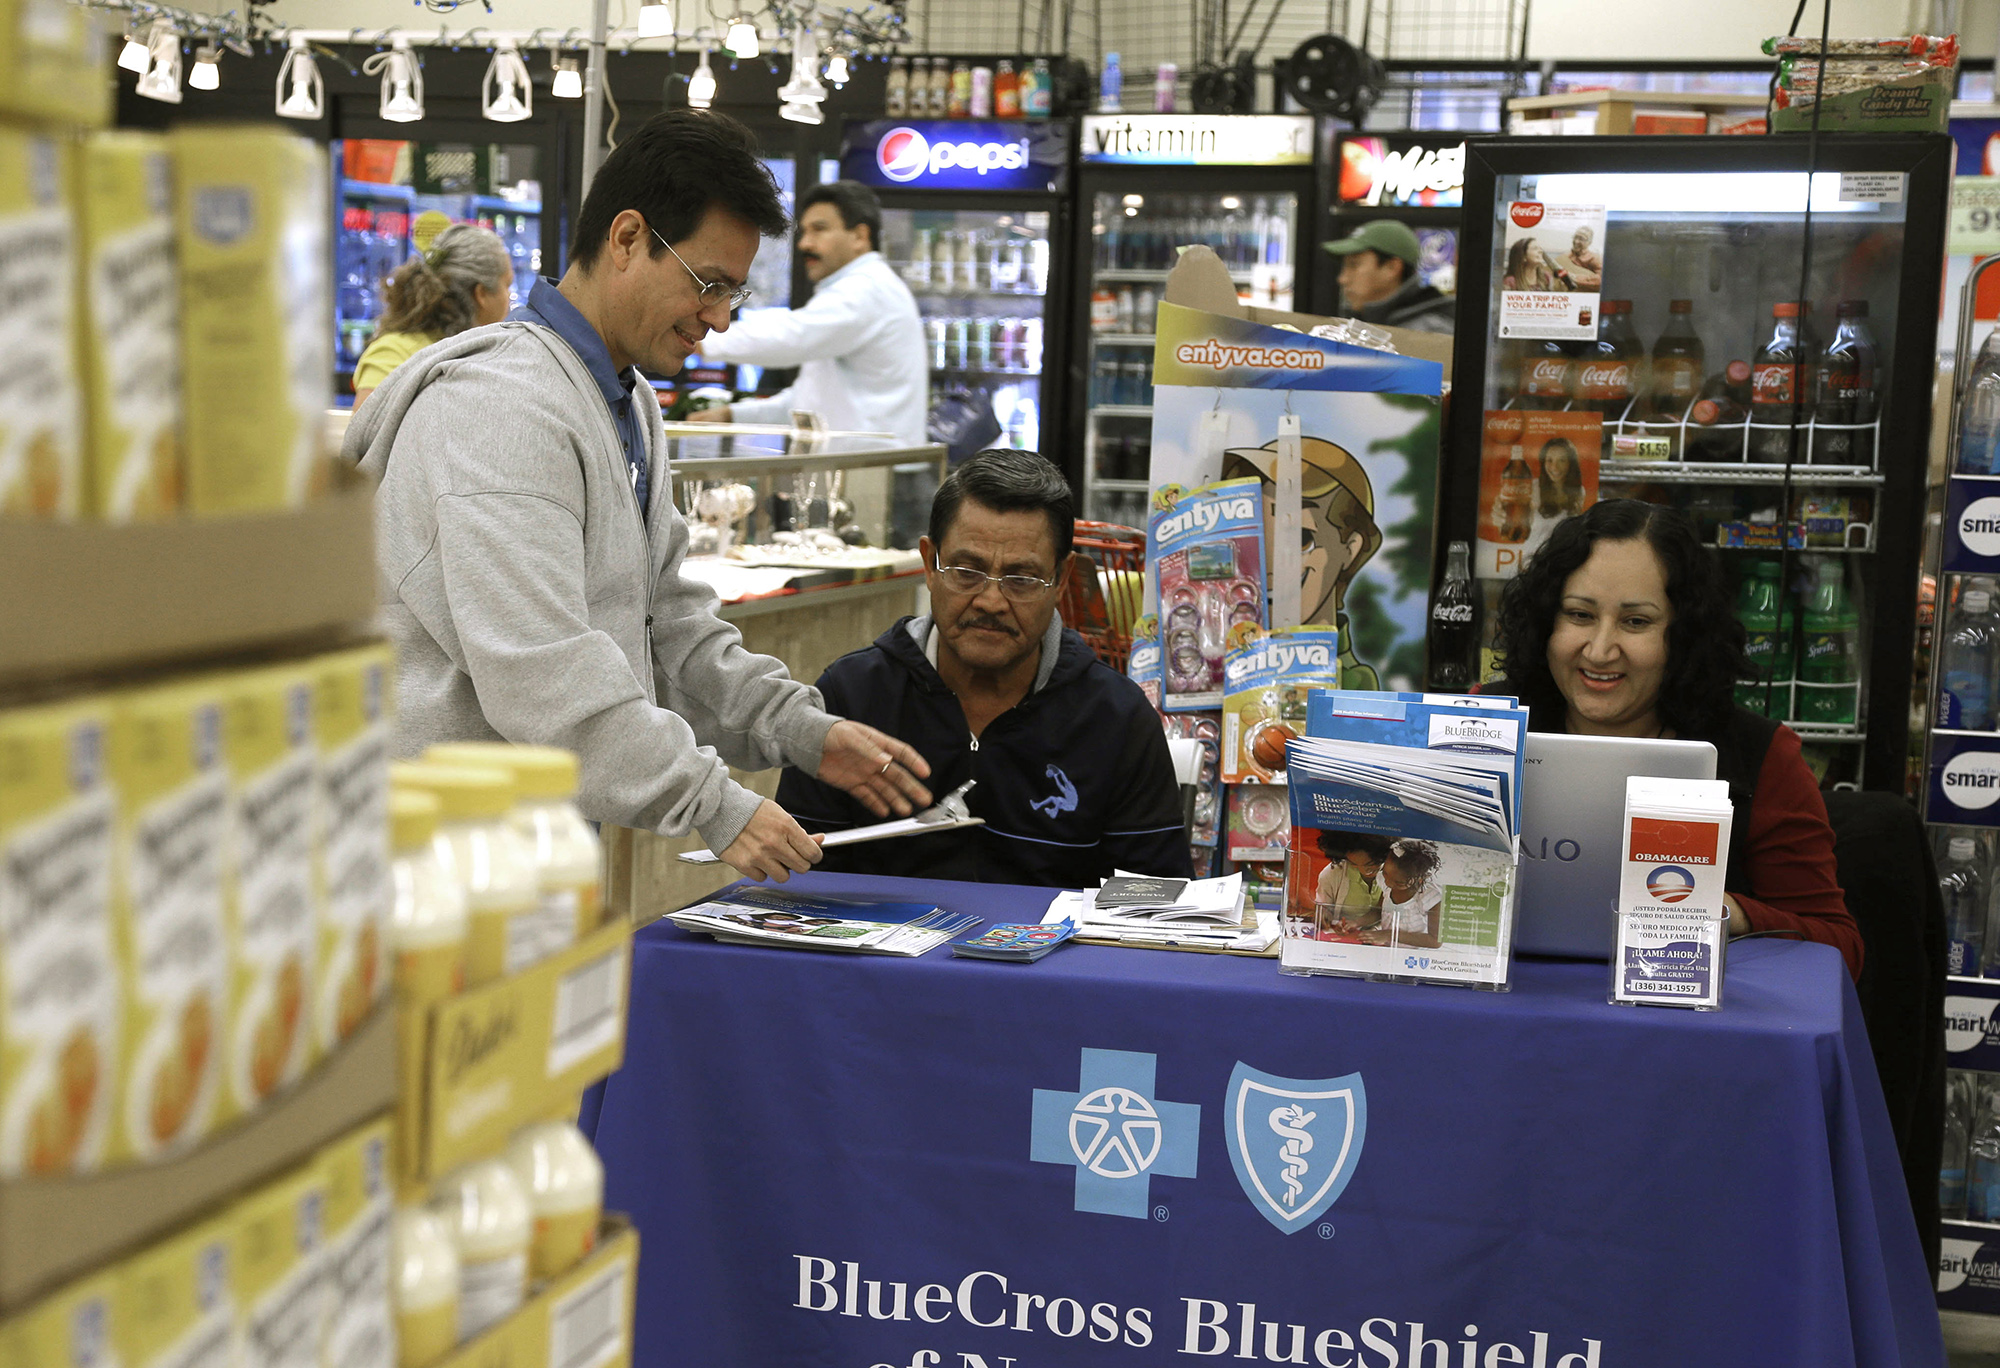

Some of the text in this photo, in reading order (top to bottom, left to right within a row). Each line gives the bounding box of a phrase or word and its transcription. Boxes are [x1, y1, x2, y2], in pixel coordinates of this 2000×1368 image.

[1873, 86, 1922, 98] Peanut
[1861, 98, 1930, 111] Candy Bar
[1095, 121, 1215, 154] vitamin
[929, 137, 1030, 175] pepsi
[1511, 205, 1543, 217] Coca-Cola
[1177, 339, 1323, 370] entyva.com
[1638, 442, 1669, 456] $1.59
[1155, 498, 1254, 542] entyva
[1433, 603, 1473, 622] Coca-Cola
[1808, 641, 1836, 658] Sprite
[1227, 643, 1330, 680] entyva
[1946, 772, 2000, 788] smar
[1312, 793, 1404, 812] BlueAdvantage
[1314, 800, 1381, 814] BlueSelect
[1315, 806, 1377, 818] BlueValue
[1317, 819, 1356, 827] individuals
[1635, 853, 1710, 864] OBAMACARE
[1667, 950, 1703, 959] AHORA!
[1635, 981, 1696, 992] (336) 341-1957
[792, 1254, 1602, 1368] BlueCross BlueShield
